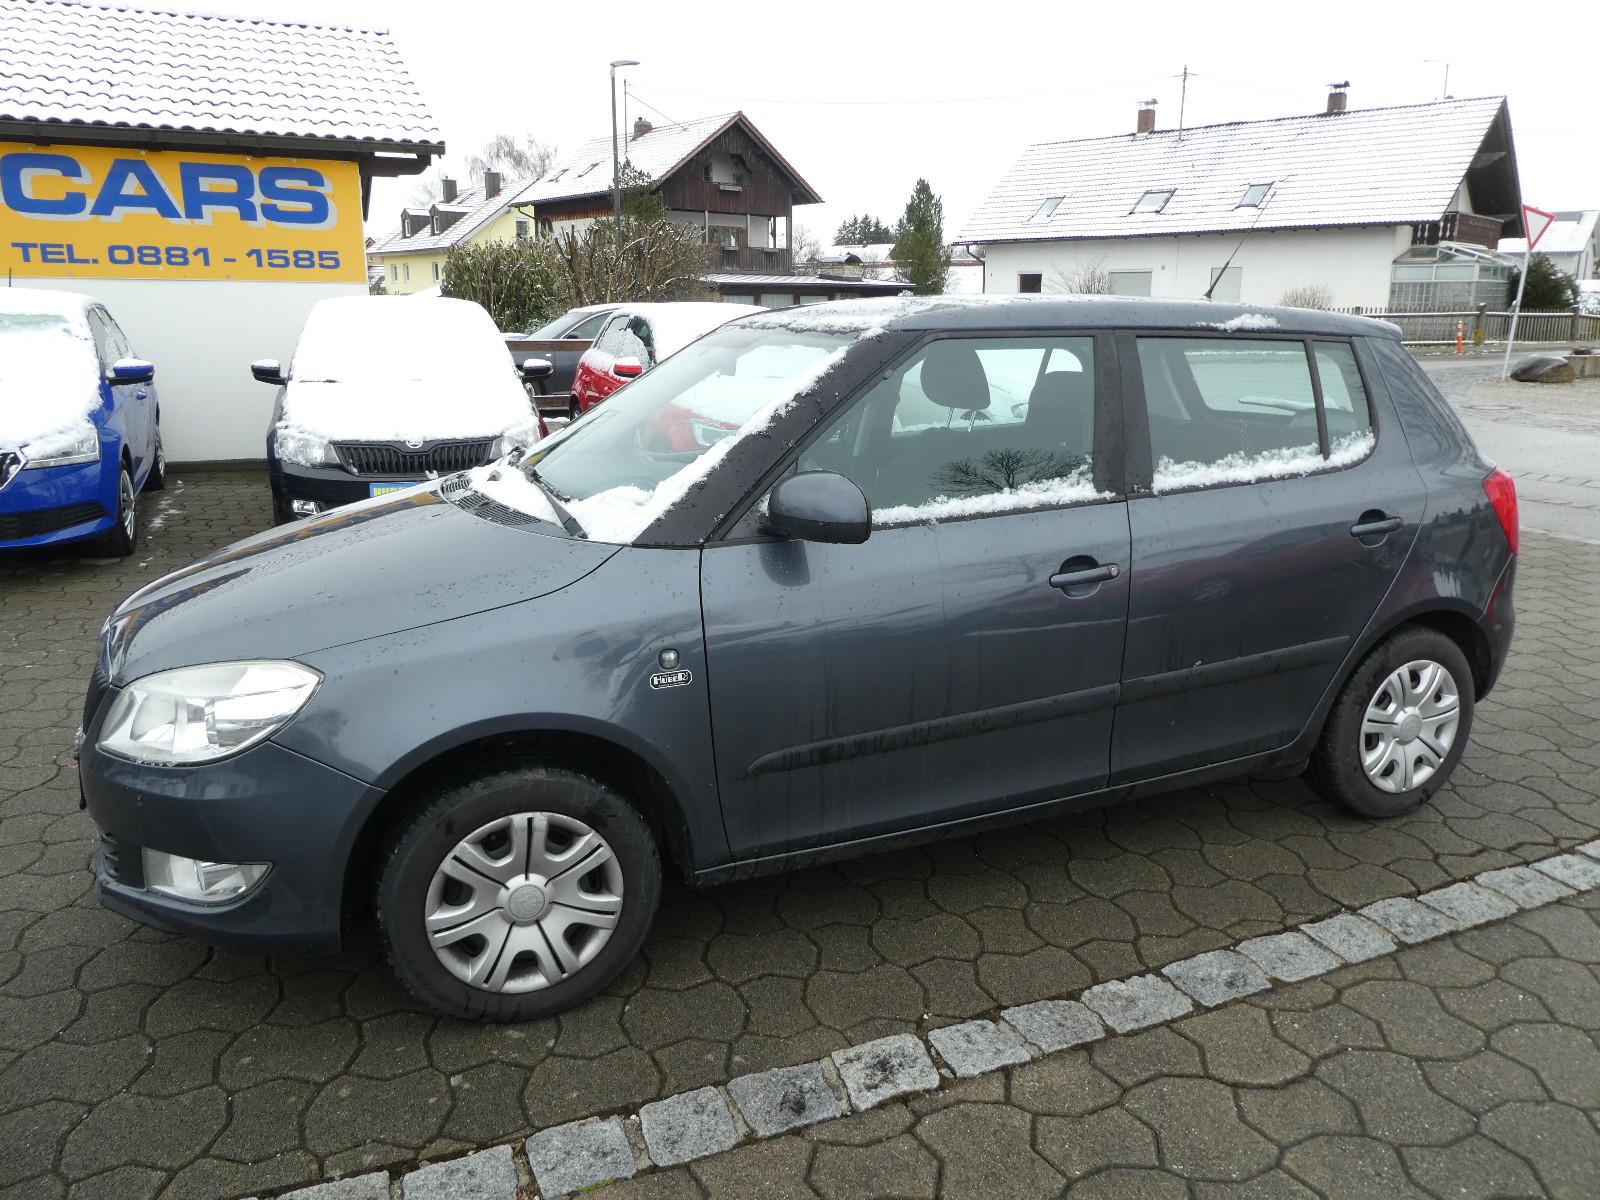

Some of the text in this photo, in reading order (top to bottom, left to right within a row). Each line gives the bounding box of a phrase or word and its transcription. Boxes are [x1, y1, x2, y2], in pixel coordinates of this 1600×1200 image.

[0, 153, 334, 228] CARS
[11, 242, 99, 264] TEL.
[107, 245, 210, 267] 0881
[245, 248, 340, 269] 1585
